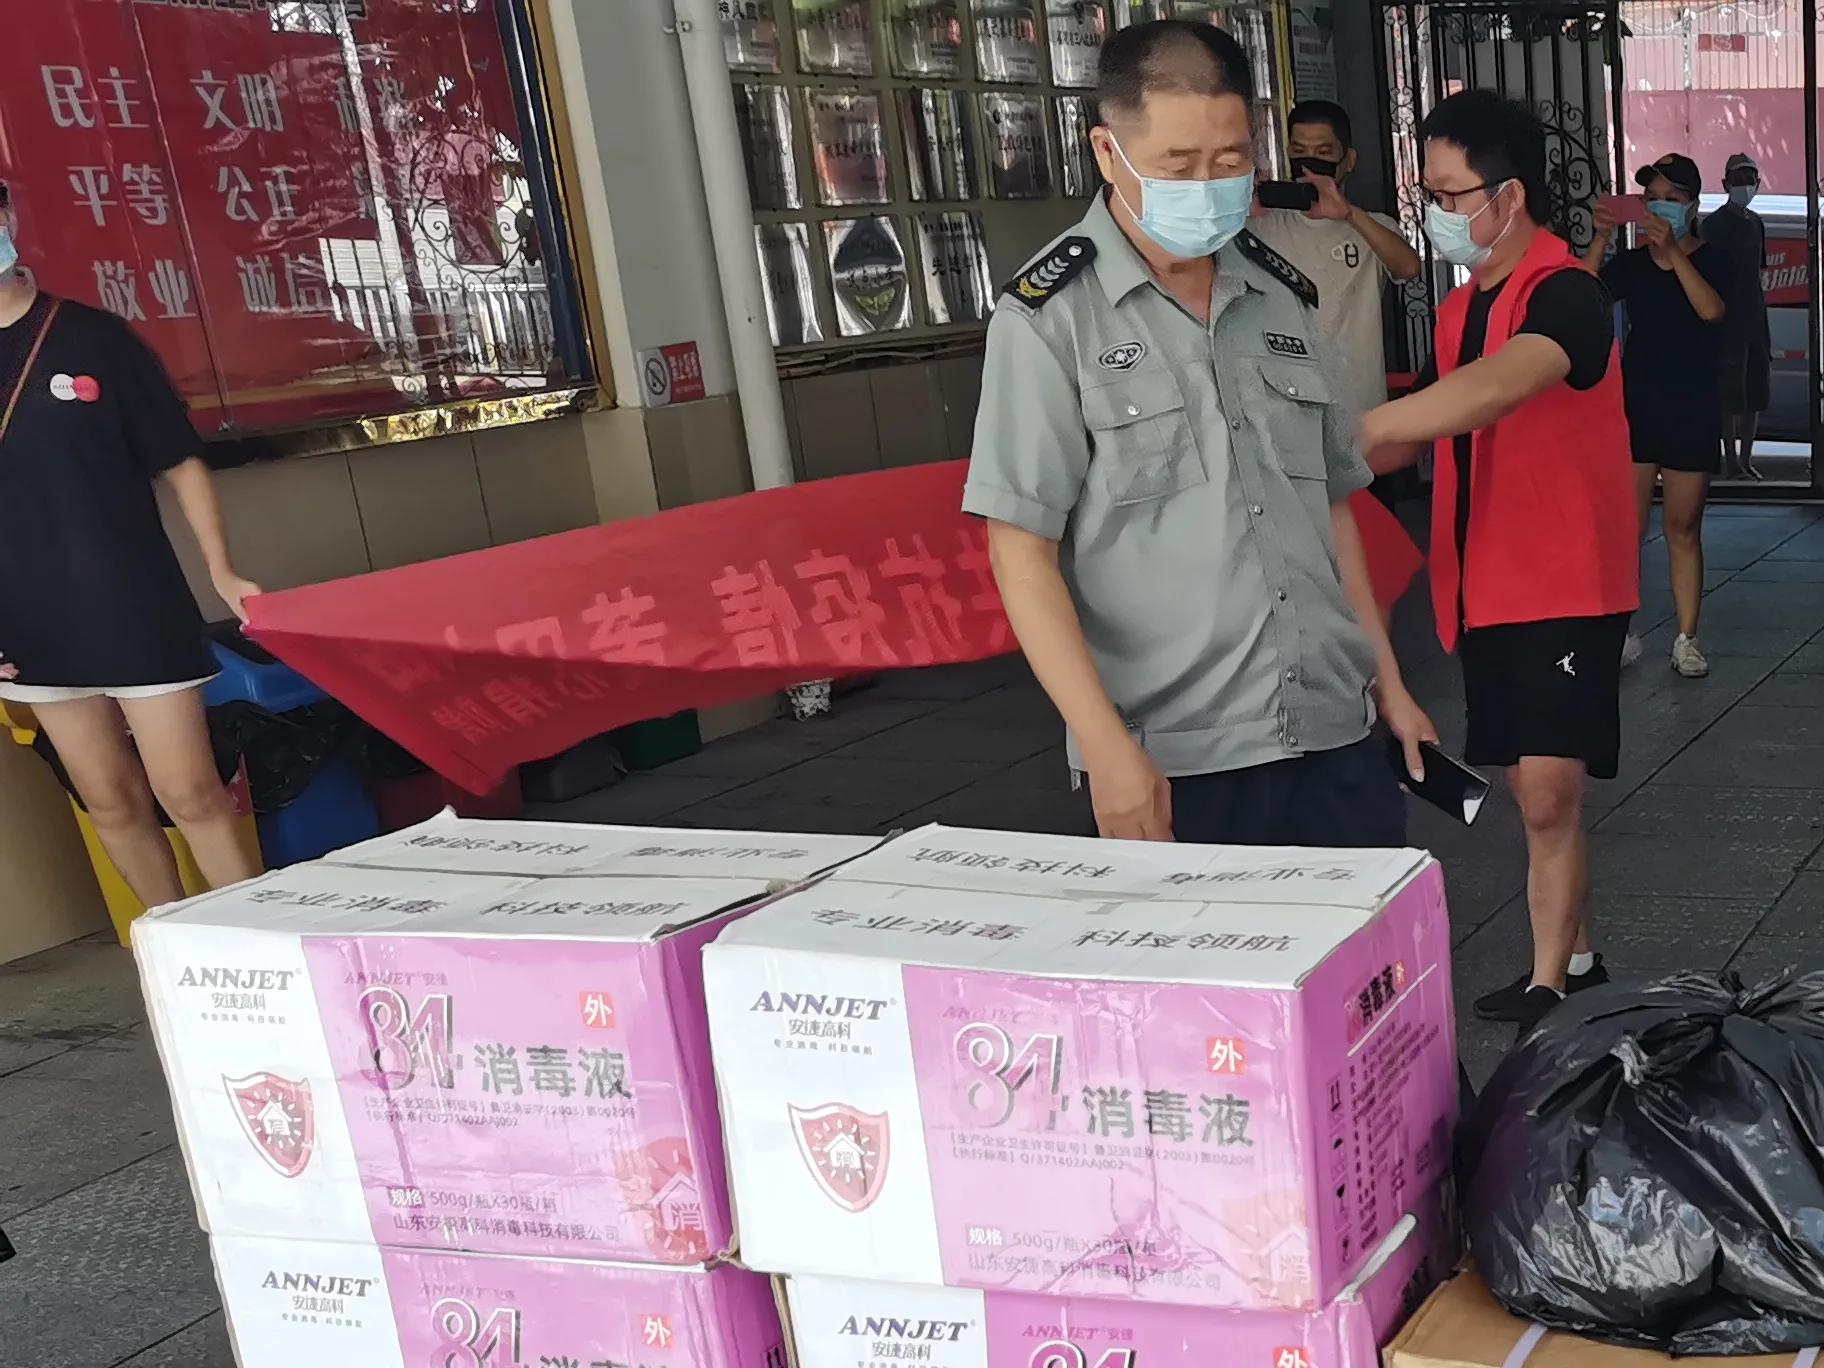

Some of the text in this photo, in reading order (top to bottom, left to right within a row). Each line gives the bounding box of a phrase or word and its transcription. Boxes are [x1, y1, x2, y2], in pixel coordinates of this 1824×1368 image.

[40, 64, 149, 128] 民主
[189, 69, 284, 132] 文明
[67, 163, 168, 226] 平等
[216, 166, 299, 222] 公正
[93, 259, 197, 321] 敬业
[247, 888, 448, 916] 专业消毒
[810, 907, 1028, 940] 专业消毒
[178, 966, 295, 992] ANNJET
[582, 994, 613, 1026] 外
[749, 991, 890, 1021] ANNJET
[358, 985, 633, 1101] 84 消毒液
[1211, 1039, 1244, 1071] 外
[947, 1021, 1255, 1148] 84 消毒液
[968, 1226, 1002, 1247] 规格
[261, 1270, 374, 1297] ANNJET
[644, 1316, 671, 1346] 外
[838, 1314, 968, 1342] ANNJET
[1022, 1324, 1098, 1340] ANNJET
